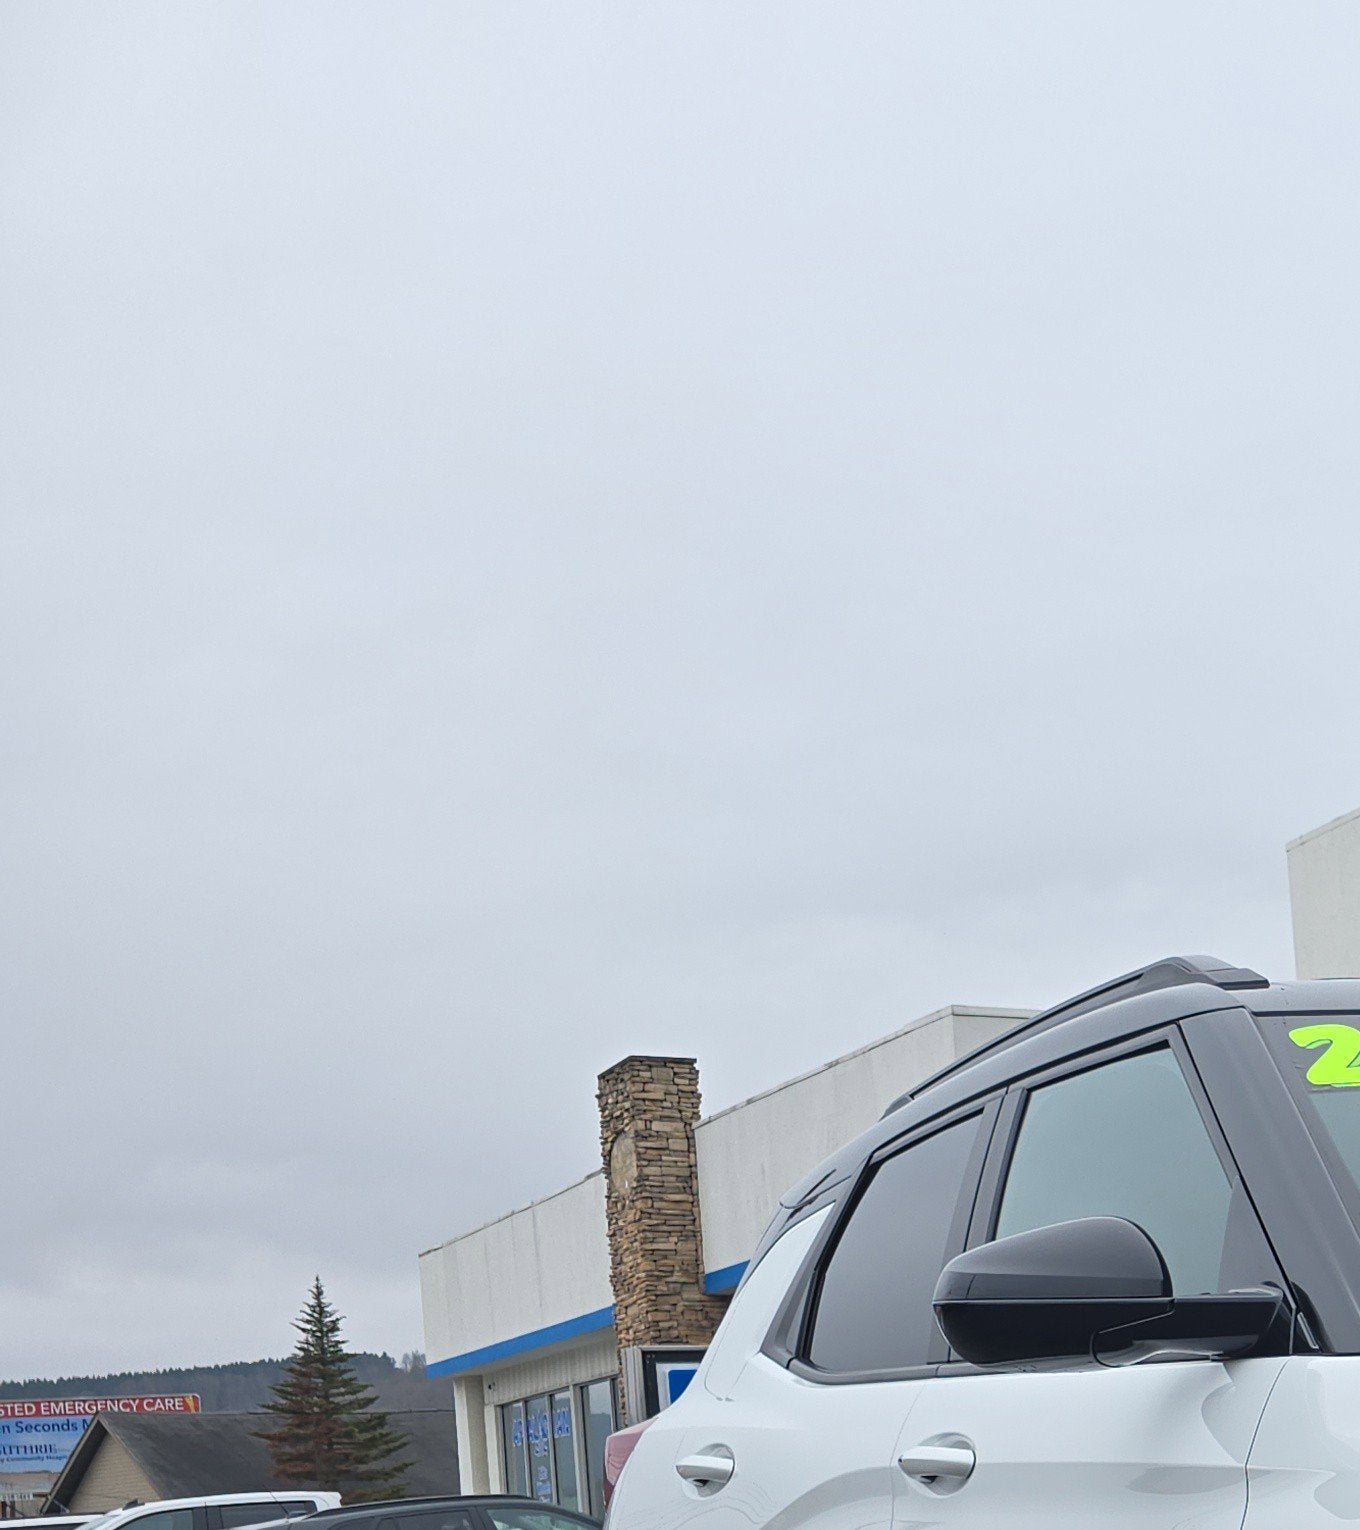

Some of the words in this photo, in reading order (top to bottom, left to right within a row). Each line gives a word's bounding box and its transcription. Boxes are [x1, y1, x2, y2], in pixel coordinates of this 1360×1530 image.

[41, 1399, 139, 1415] EMERGENCY
[143, 1398, 185, 1412] CARE
[15, 1418, 78, 1434] Seconds
